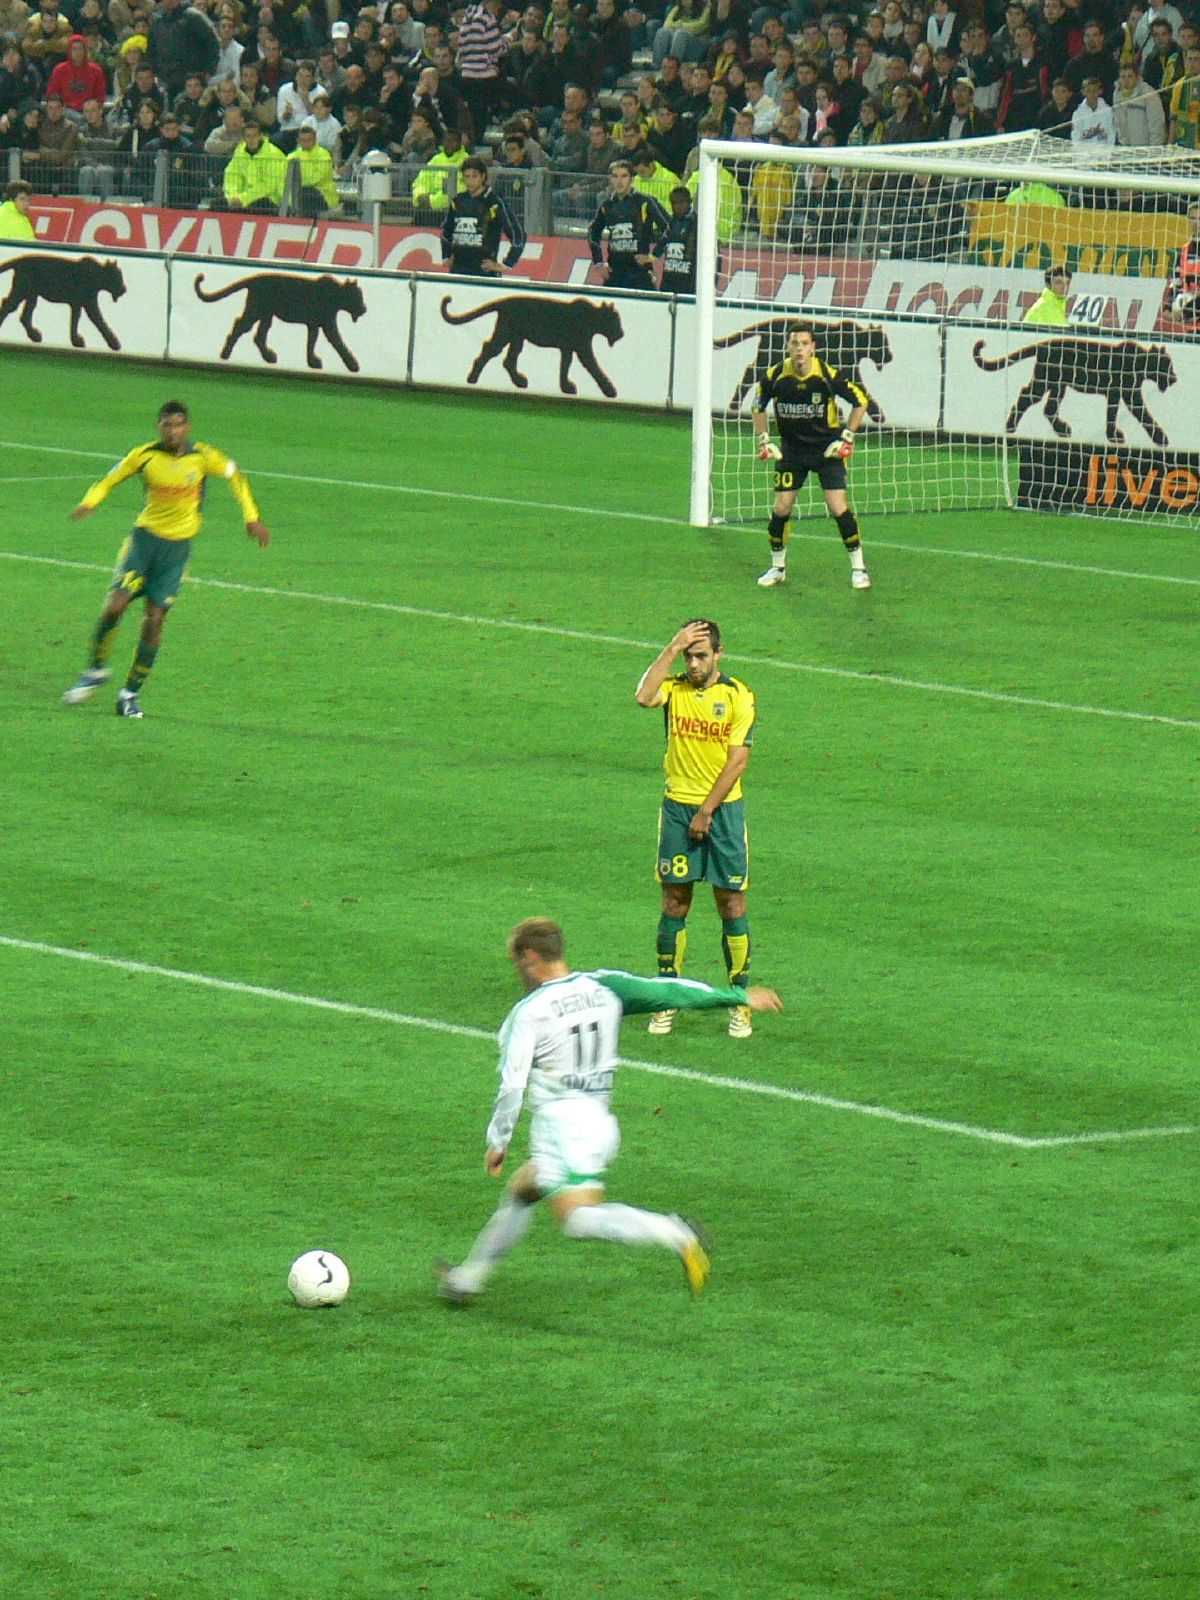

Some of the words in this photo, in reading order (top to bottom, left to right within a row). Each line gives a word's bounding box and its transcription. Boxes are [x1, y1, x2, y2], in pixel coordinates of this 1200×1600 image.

[1073, 295, 1103, 323] 40
[1086, 454, 1200, 508] live
[672, 854, 689, 878] 8
[567, 1020, 601, 1068] 11
